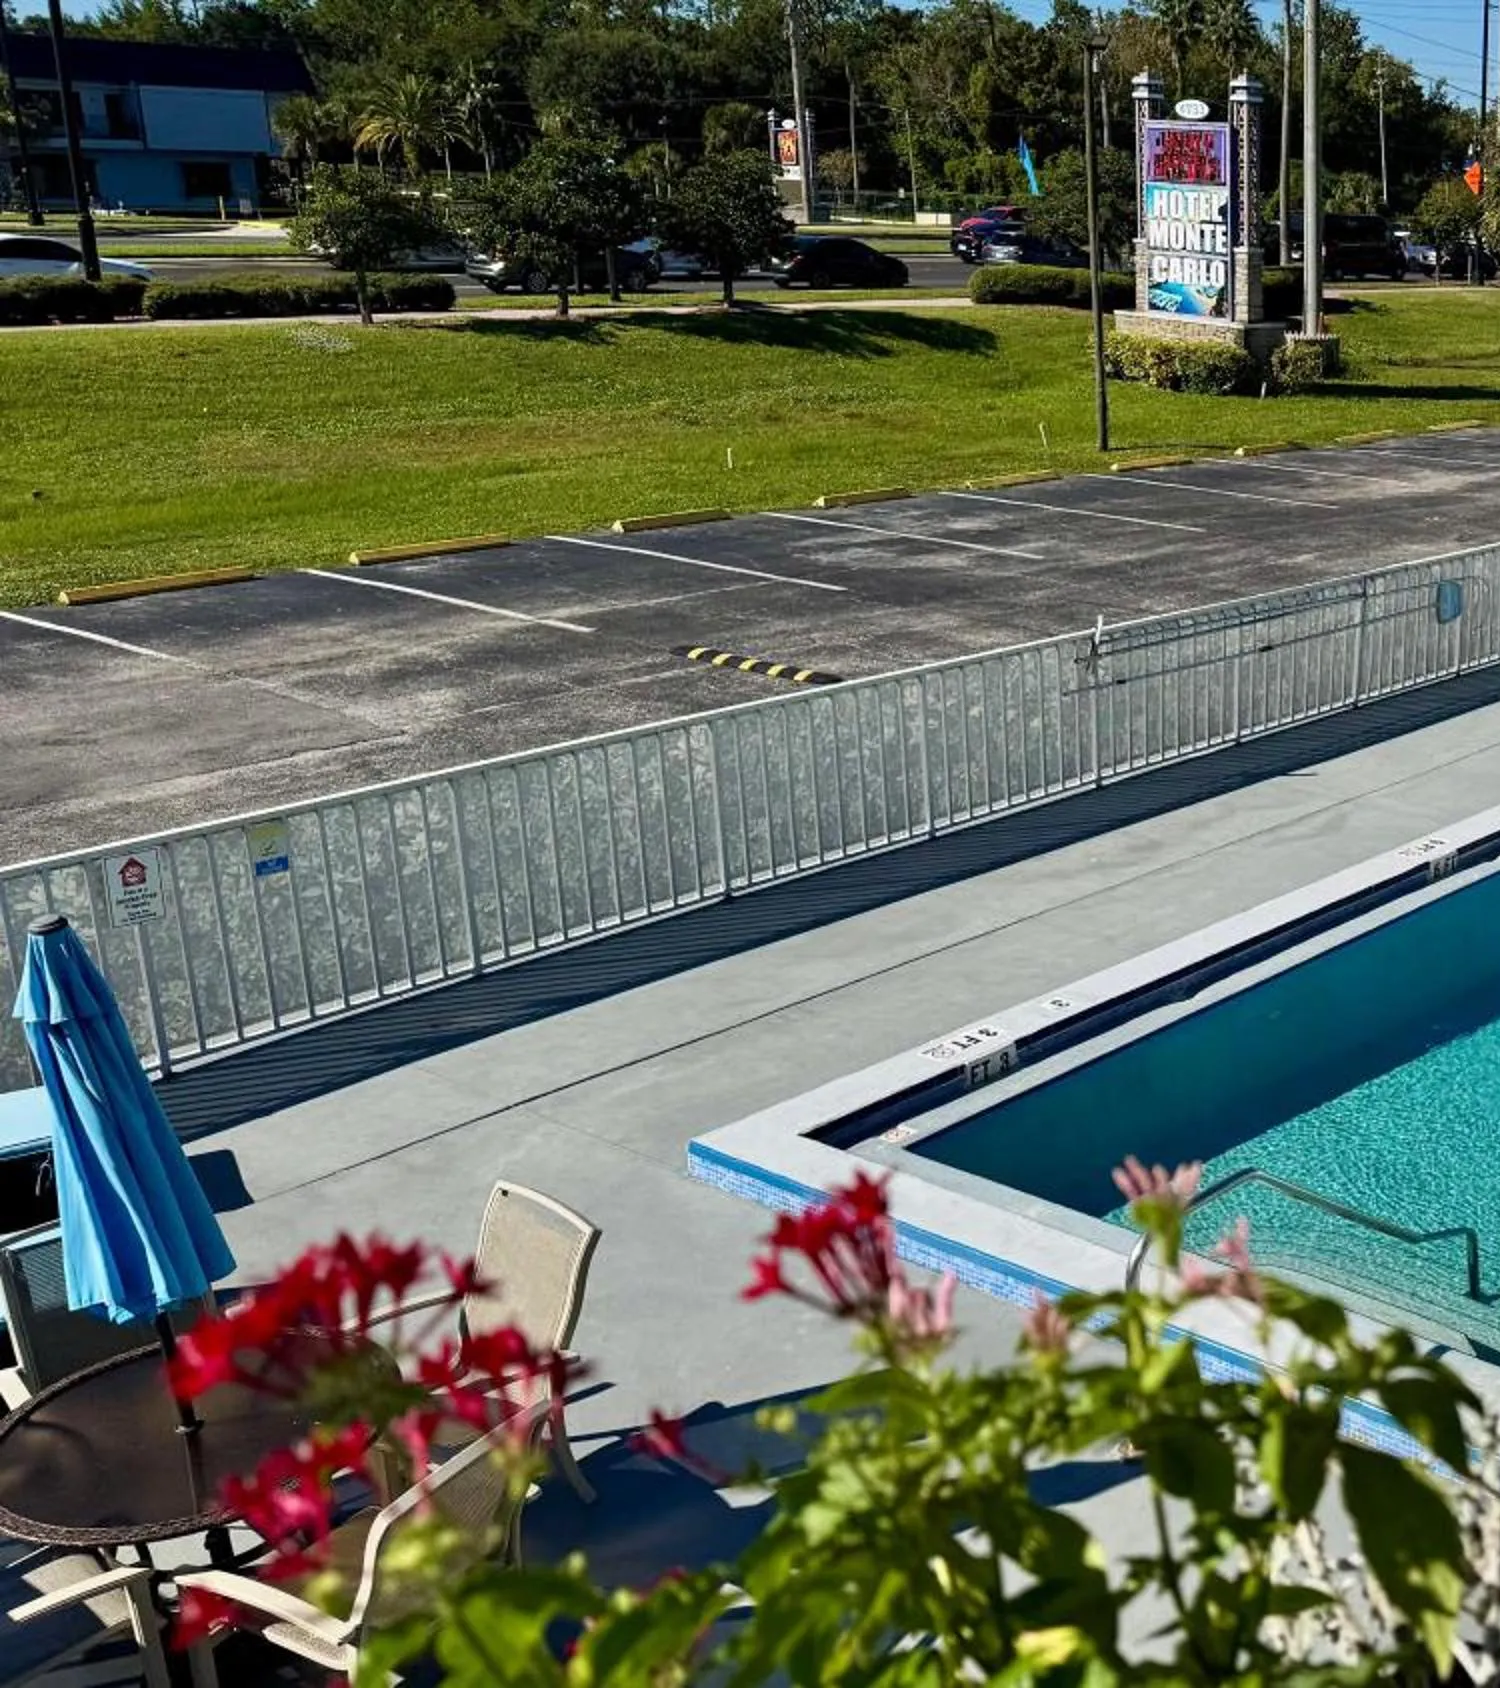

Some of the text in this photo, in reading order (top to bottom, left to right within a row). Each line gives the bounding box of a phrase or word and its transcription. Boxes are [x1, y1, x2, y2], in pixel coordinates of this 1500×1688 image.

[1153, 189, 1223, 222] HOTEL
[1149, 219, 1228, 254] MONTE
[1151, 255, 1226, 289] CARLO
[952, 1035, 983, 1050] FT
[970, 1058, 991, 1086] FT
